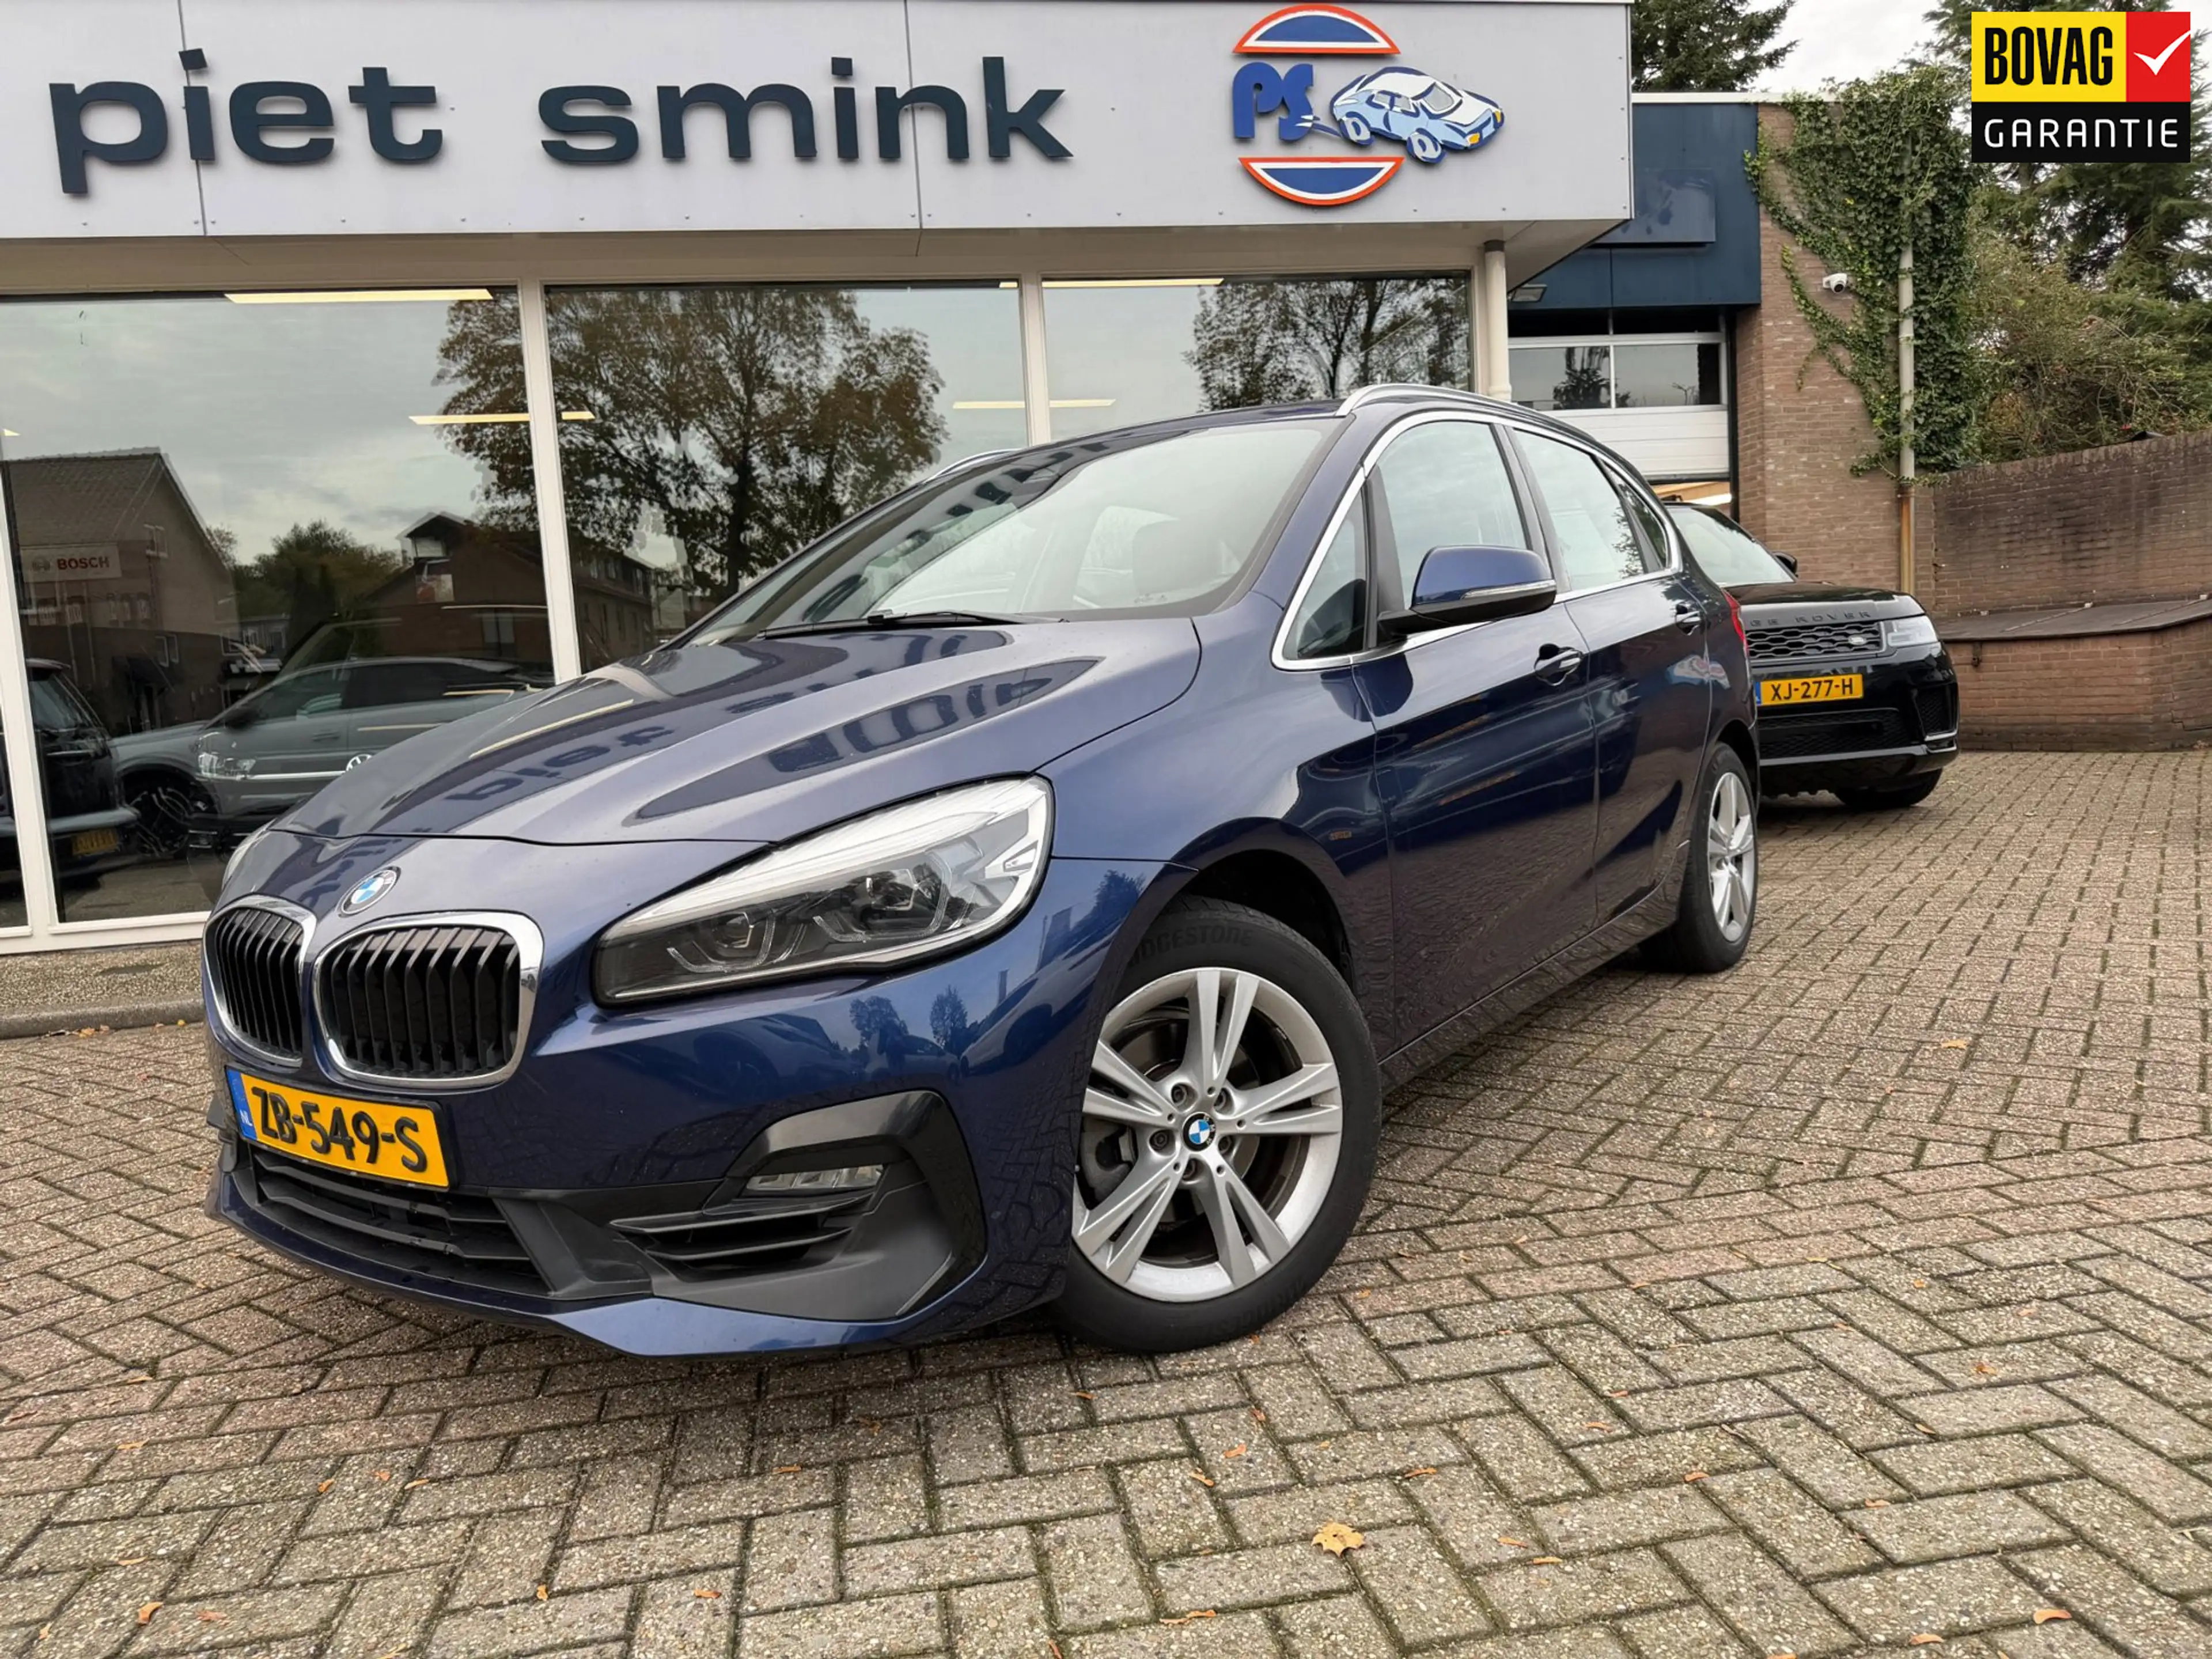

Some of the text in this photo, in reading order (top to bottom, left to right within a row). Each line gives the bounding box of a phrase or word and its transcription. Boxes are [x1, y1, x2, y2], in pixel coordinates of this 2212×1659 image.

[1232, 62, 1313, 142] PS
[49, 48, 1073, 194] piet smink
[56, 556, 110, 570] BOSCH
[1795, 611, 1871, 623] ROVER
[1771, 677, 1853, 701] XJ-277-H
[241, 1109, 253, 1126] NL
[251, 1086, 427, 1173] ZB-549-S
